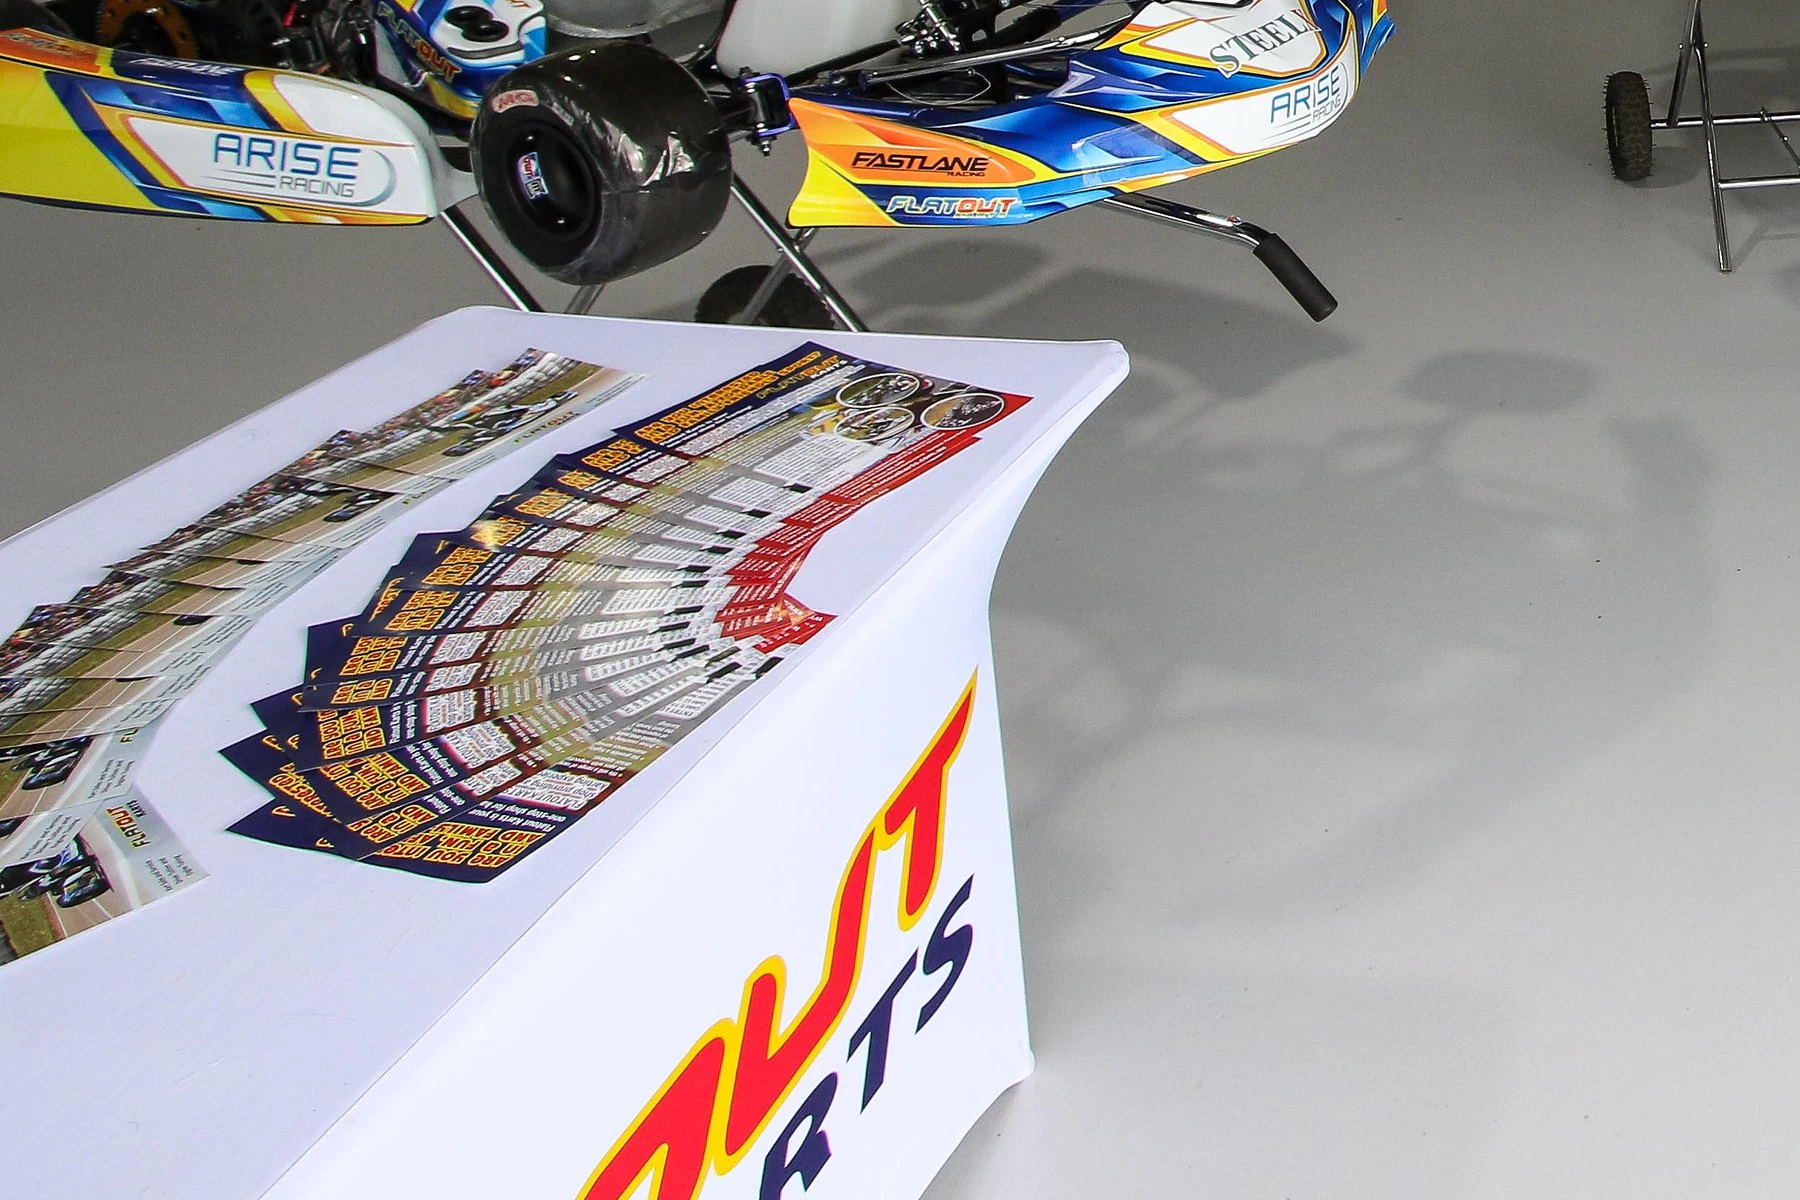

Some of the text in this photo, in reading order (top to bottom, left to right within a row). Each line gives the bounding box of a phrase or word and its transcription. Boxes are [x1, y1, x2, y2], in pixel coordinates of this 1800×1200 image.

[376, 0, 462, 83] FLATOUT
[1210, 9, 1321, 76] STEELX
[1270, 66, 1340, 123] ARISE
[1312, 95, 1340, 124] RACING
[213, 134, 361, 180] ARISE
[852, 152, 989, 172] FASTLANE
[278, 175, 355, 199] RACING
[886, 196, 1018, 214] FLATOUT
[365, 728, 385, 749] AND
[397, 773, 431, 794] AND
[533, 777, 596, 801] shop providing
[127, 799, 147, 818] KARTS
[400, 805, 439, 825] AND
[493, 802, 505, 813] for
[505, 805, 527, 817] shop
[106, 805, 151, 848] FLATOUT
[469, 809, 556, 832] Flatout Karts is your
[499, 830, 546, 844] AND
